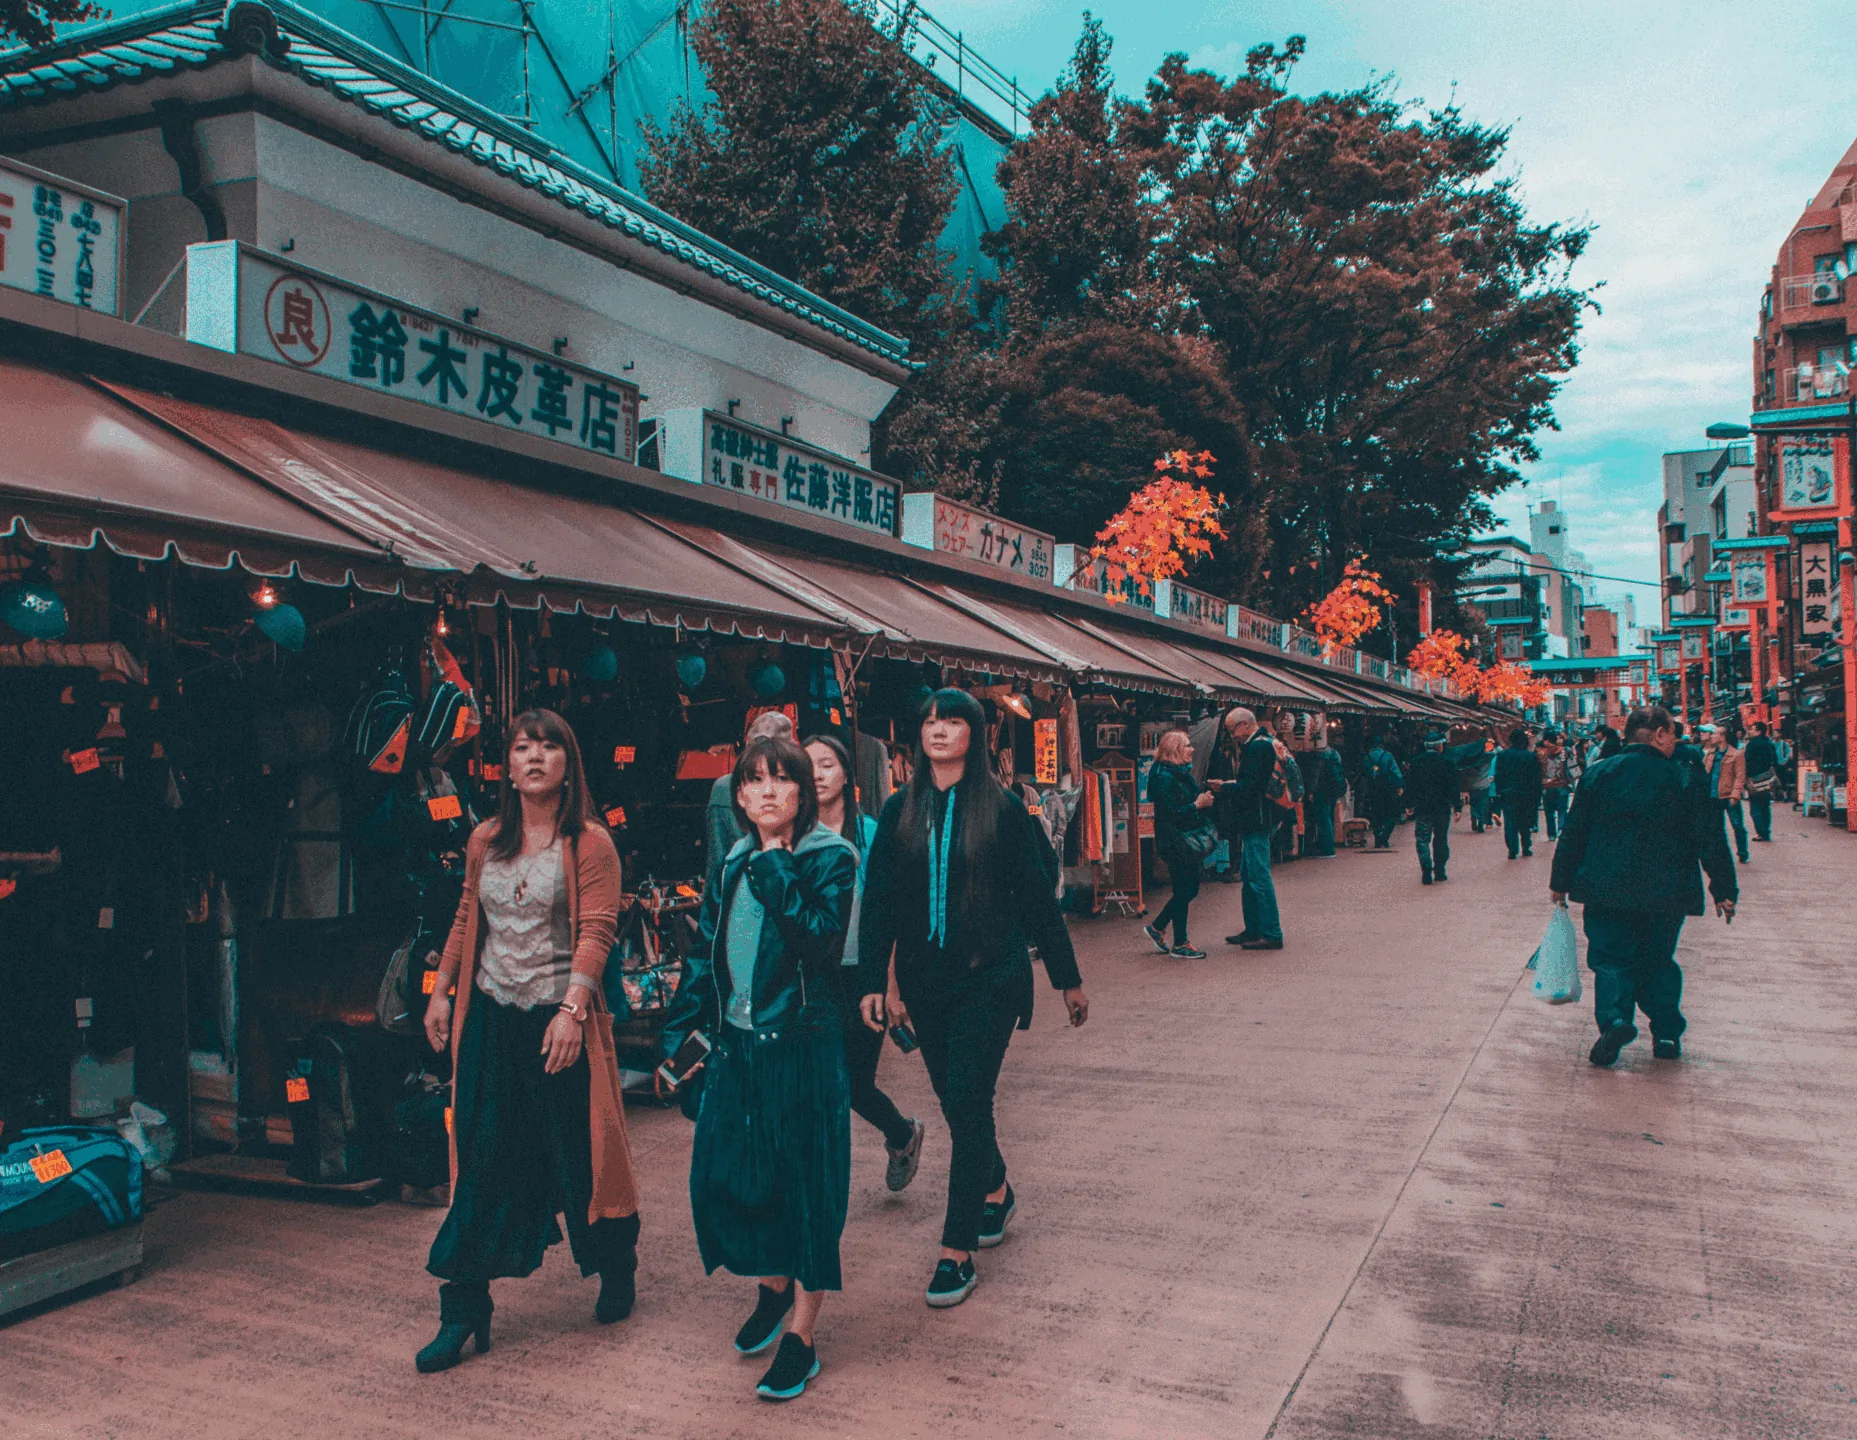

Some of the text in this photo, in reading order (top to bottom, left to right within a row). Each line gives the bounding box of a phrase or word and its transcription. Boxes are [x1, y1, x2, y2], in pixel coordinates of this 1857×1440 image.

[276, 287, 319, 355] 良
[347, 302, 621, 455] 鈴木皮革店
[783, 454, 894, 533] 佐藤洋服店
[980, 521, 1023, 567] カナメ
[1029, 561, 1049, 579] 3027
[1805, 554, 1829, 624] 大黒家
